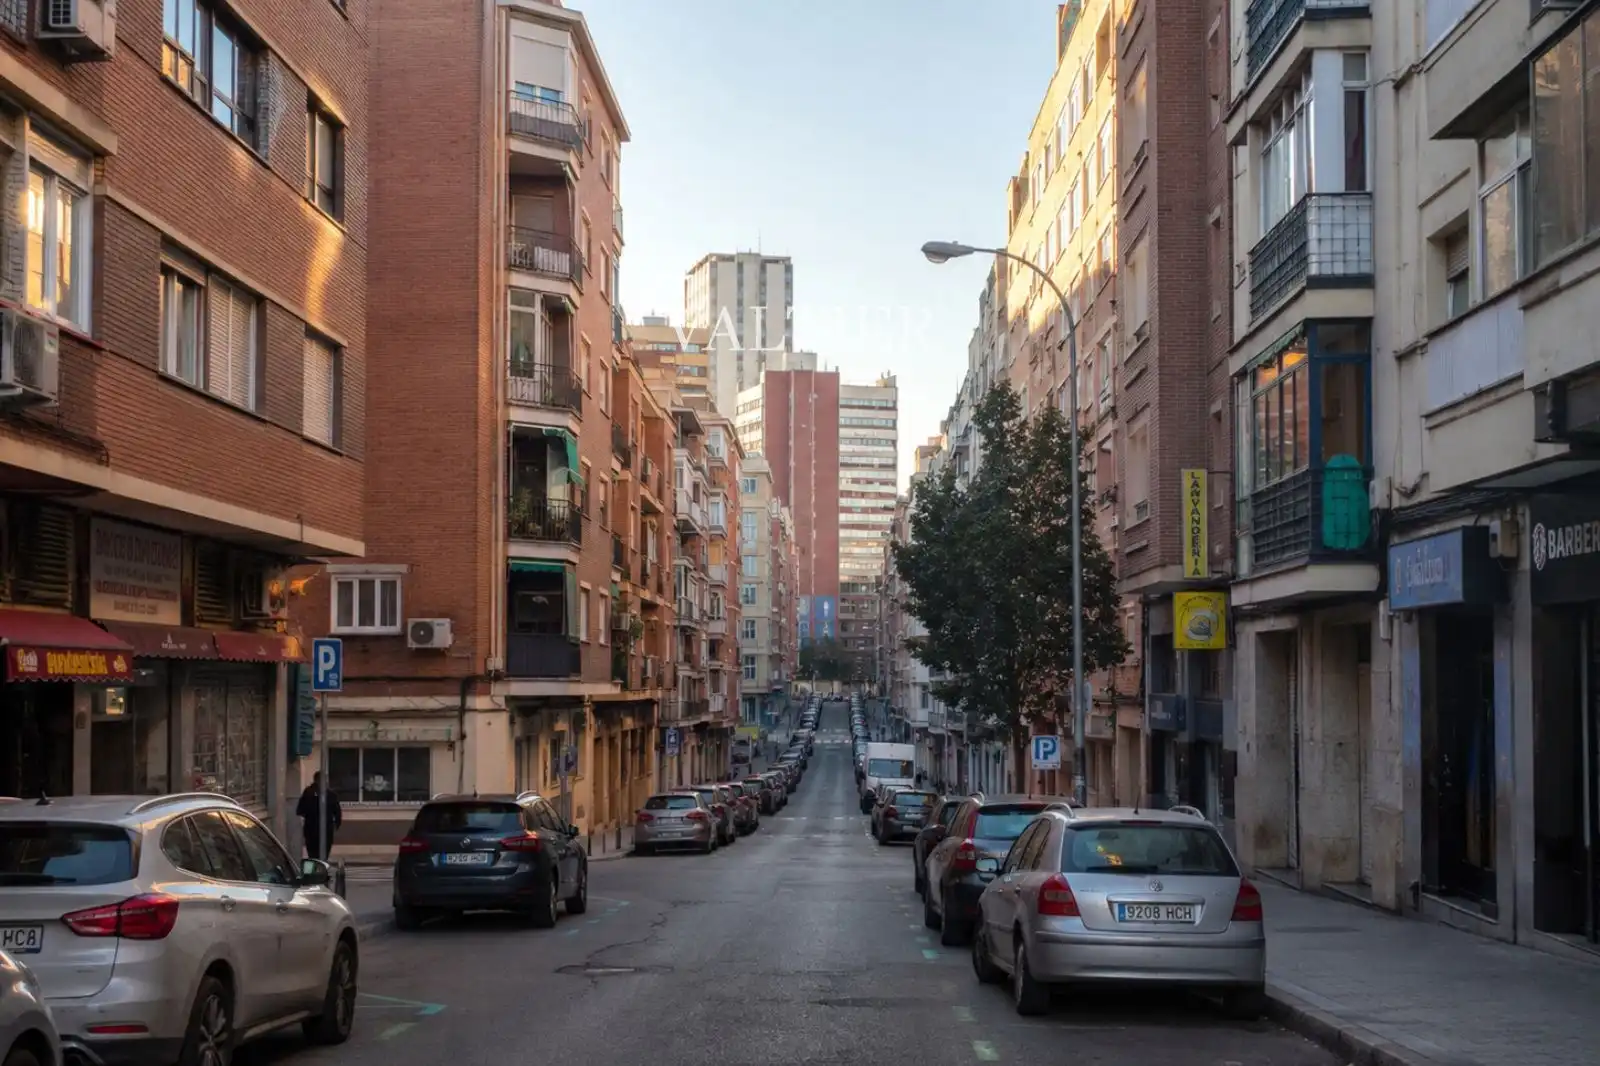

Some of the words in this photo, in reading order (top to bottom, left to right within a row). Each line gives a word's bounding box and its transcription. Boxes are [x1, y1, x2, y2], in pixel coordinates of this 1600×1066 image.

[318, 644, 336, 683] P
[1035, 737, 1056, 760] P
[1127, 905, 1160, 919] 9208
[1166, 906, 1192, 920] HCH
